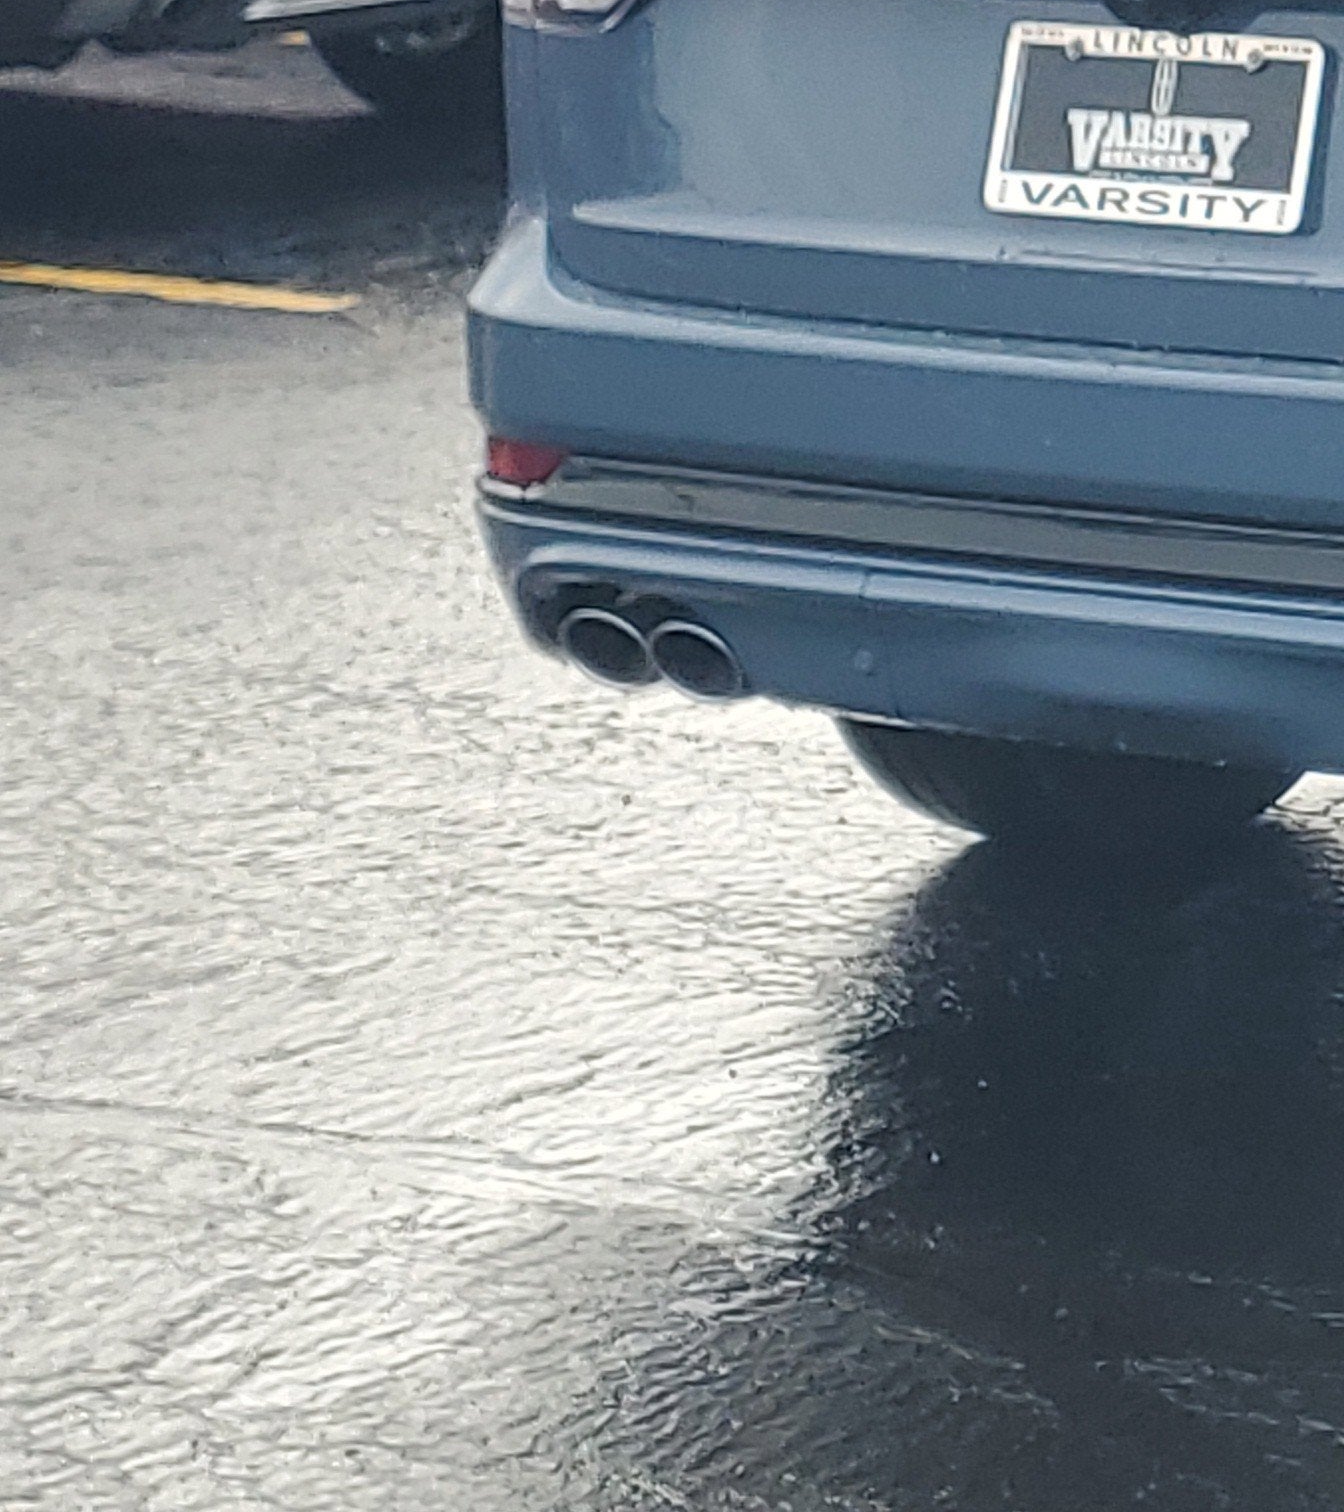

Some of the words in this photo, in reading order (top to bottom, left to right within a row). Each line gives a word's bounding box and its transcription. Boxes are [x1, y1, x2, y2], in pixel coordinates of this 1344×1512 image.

[1093, 28, 1239, 60] LINCOLN
[1067, 108, 1250, 181] VARSITY
[1021, 180, 1267, 223] VARSITY
